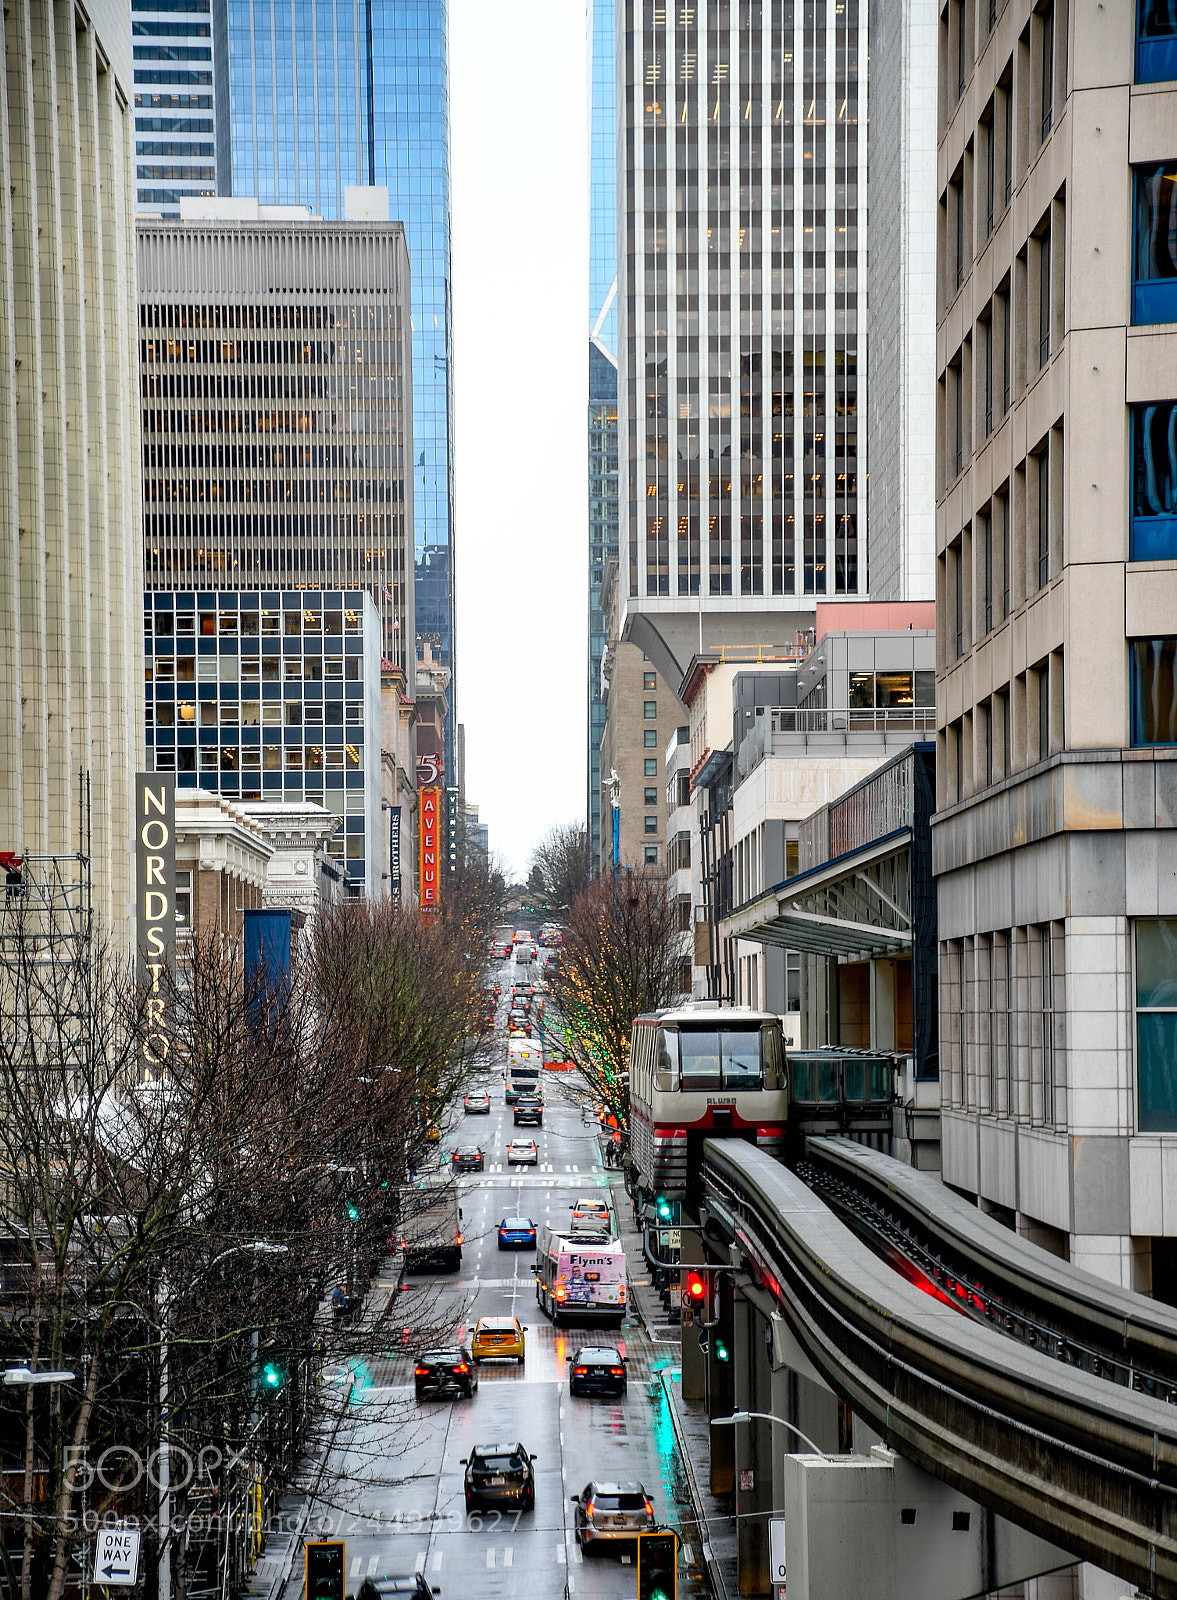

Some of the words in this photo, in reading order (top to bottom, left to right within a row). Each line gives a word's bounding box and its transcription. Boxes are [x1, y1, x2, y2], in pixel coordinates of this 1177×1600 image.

[392, 814, 400, 880] BROTHERS
[424, 800, 434, 900] AVENUE
[570, 1254, 613, 1268] Flynn's
[105, 1535, 131, 1548] ONE
[103, 1549, 131, 1562] WAY
